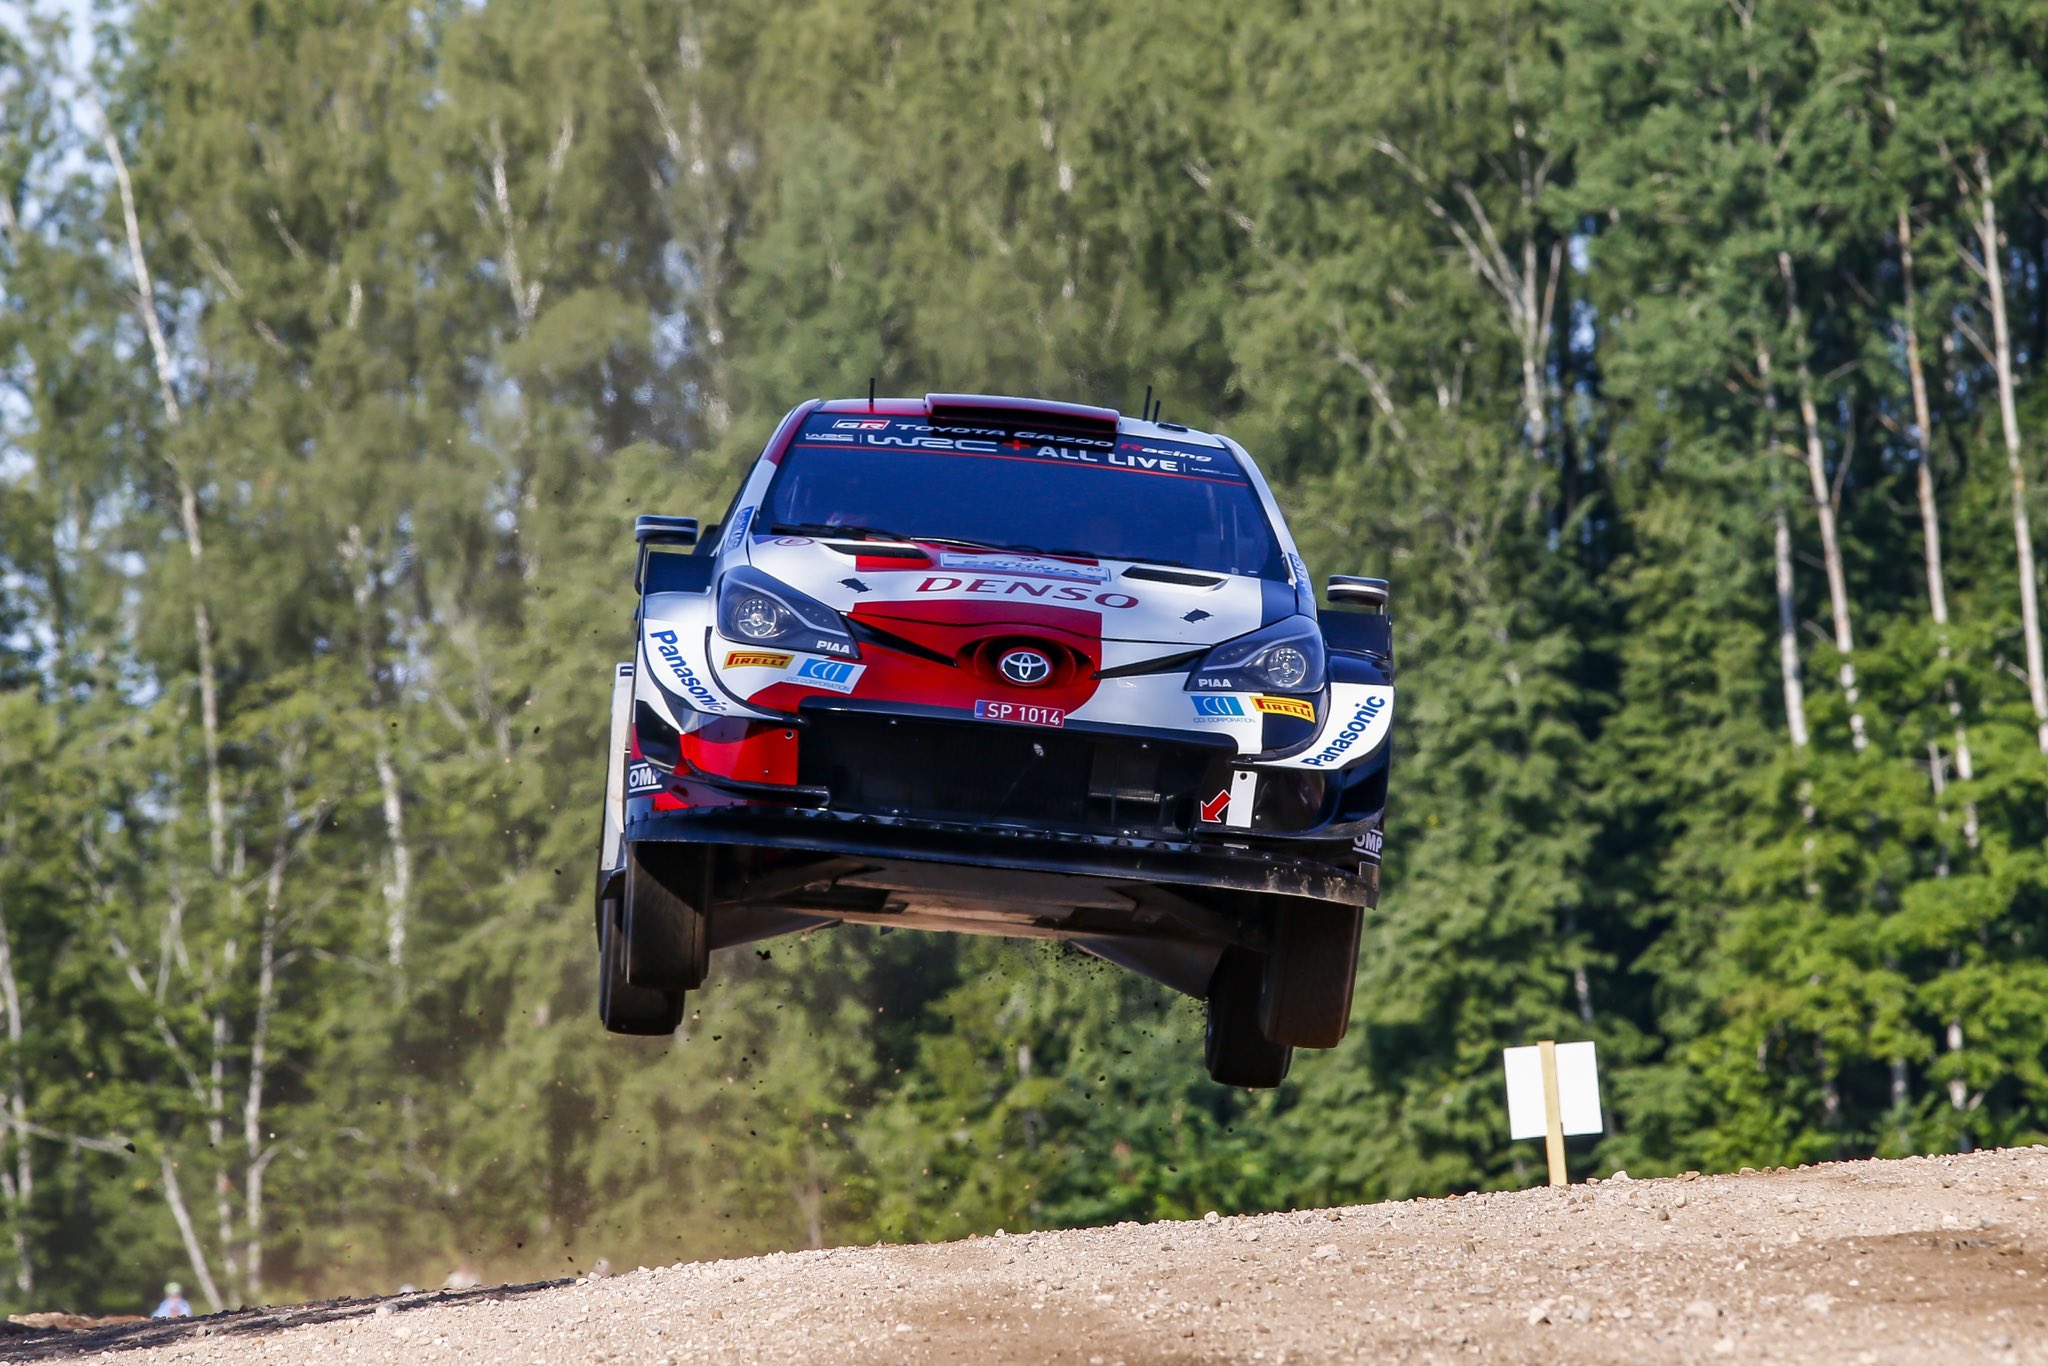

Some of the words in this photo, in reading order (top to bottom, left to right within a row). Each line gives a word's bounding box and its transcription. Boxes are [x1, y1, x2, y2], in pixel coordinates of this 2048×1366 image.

[835, 420, 887, 431] GR
[896, 423, 1005, 437] TOYOTA
[1013, 431, 1114, 447] GAZOO
[1120, 442, 1212, 462] Racing
[1036, 446, 1098, 462] ALL
[1108, 453, 1178, 472] LIVE
[915, 577, 1139, 609] DENSO
[816, 640, 850, 653] PIAA
[650, 630, 727, 711] Panasonic
[727, 652, 789, 666] PIRELLI
[1198, 679, 1232, 688] PIAA
[987, 703, 1013, 719] SP
[1018, 706, 1060, 725] 1014
[1255, 698, 1312, 718] PIRELLI
[1301, 696, 1386, 766] Panasonic
